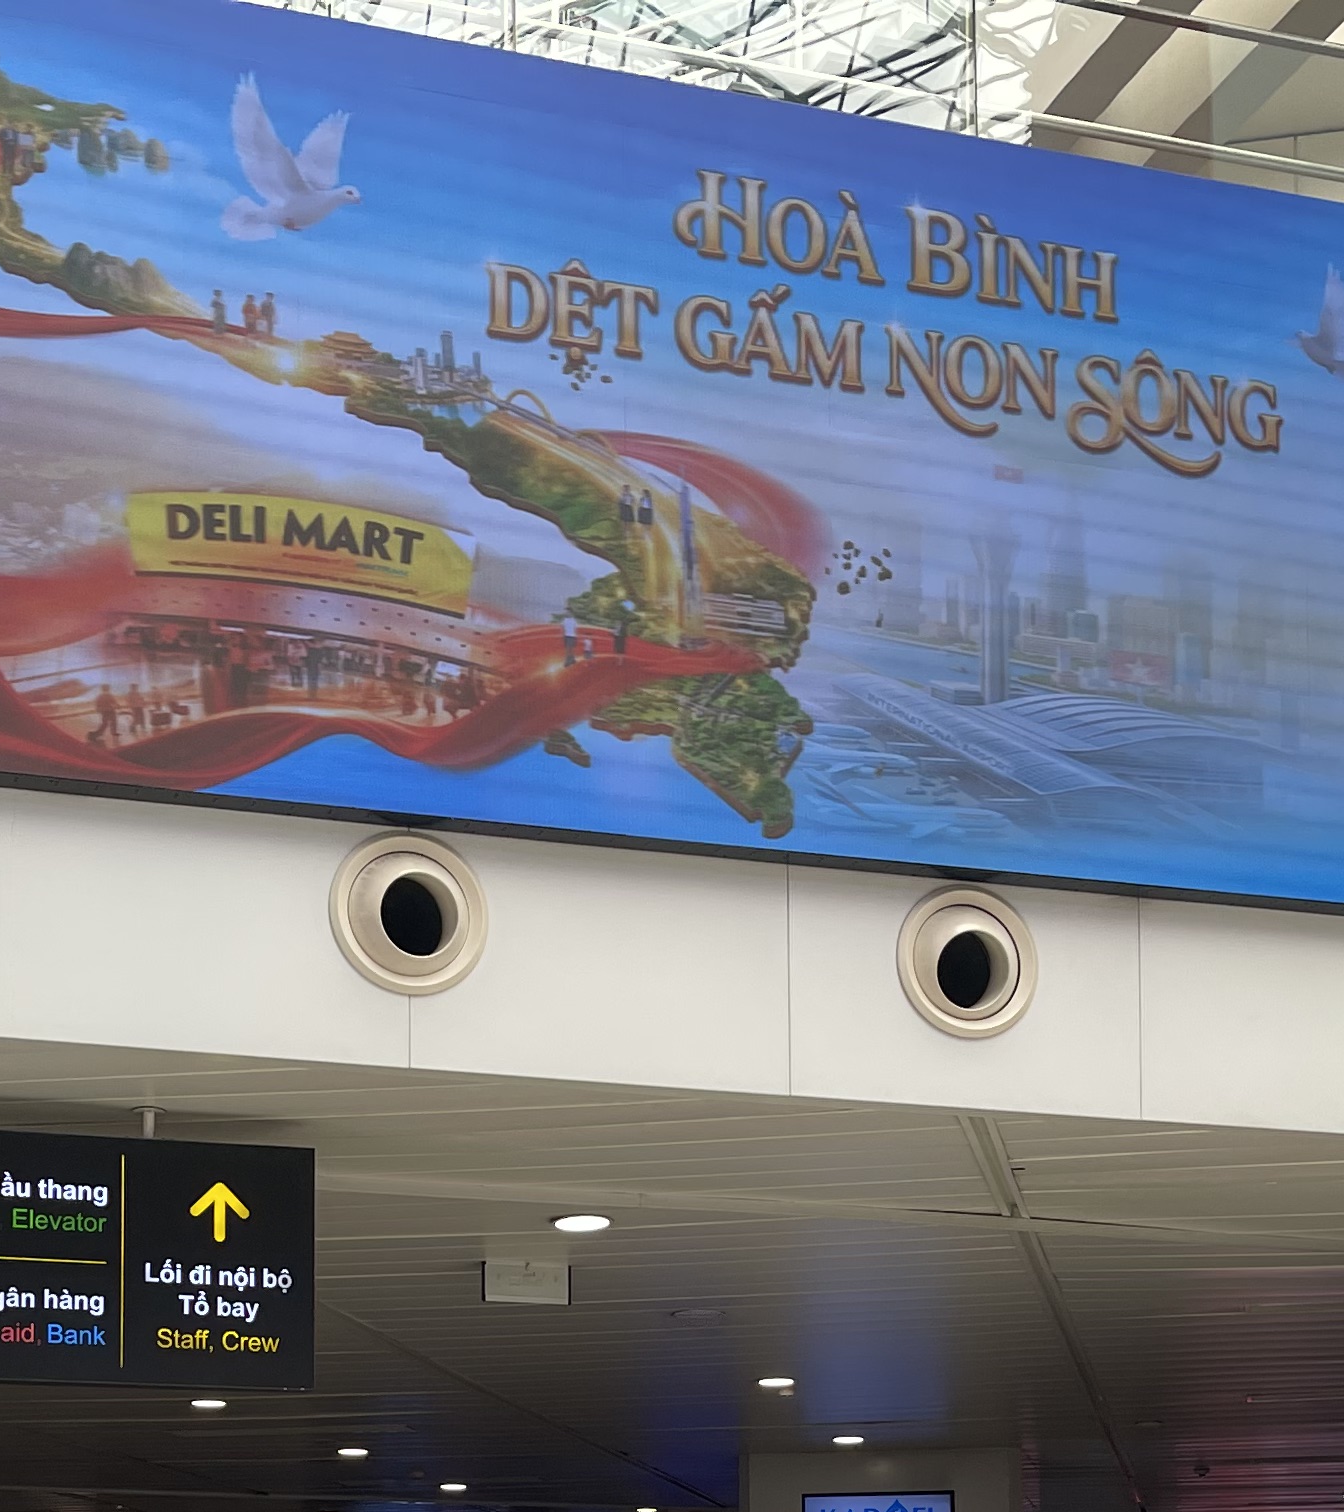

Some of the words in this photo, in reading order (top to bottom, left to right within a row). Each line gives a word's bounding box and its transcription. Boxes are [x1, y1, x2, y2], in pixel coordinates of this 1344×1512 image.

[675, 168, 884, 286] HOÀ
[906, 202, 1119, 323] BÌNH
[486, 257, 658, 368] DỆT
[674, 284, 866, 393] GẤM
[885, 322, 1061, 435] NON
[1067, 348, 1284, 477] SÔNG
[166, 503, 266, 544] DELI
[281, 509, 425, 565] MART
[37, 1177, 108, 1207] thang
[12, 1206, 107, 1233] Elevator
[145, 1258, 182, 1285] Lối
[188, 1262, 212, 1286] đi
[217, 1264, 257, 1293] nội
[262, 1265, 293, 1293] bộ
[42, 1286, 105, 1317] hàng
[178, 1289, 211, 1317] Tổ
[216, 1295, 259, 1324] bay
[0, 1320, 41, 1347] aid,
[47, 1321, 106, 1346] Bank
[156, 1326, 215, 1353] Staff,
[221, 1329, 280, 1354] Crew
